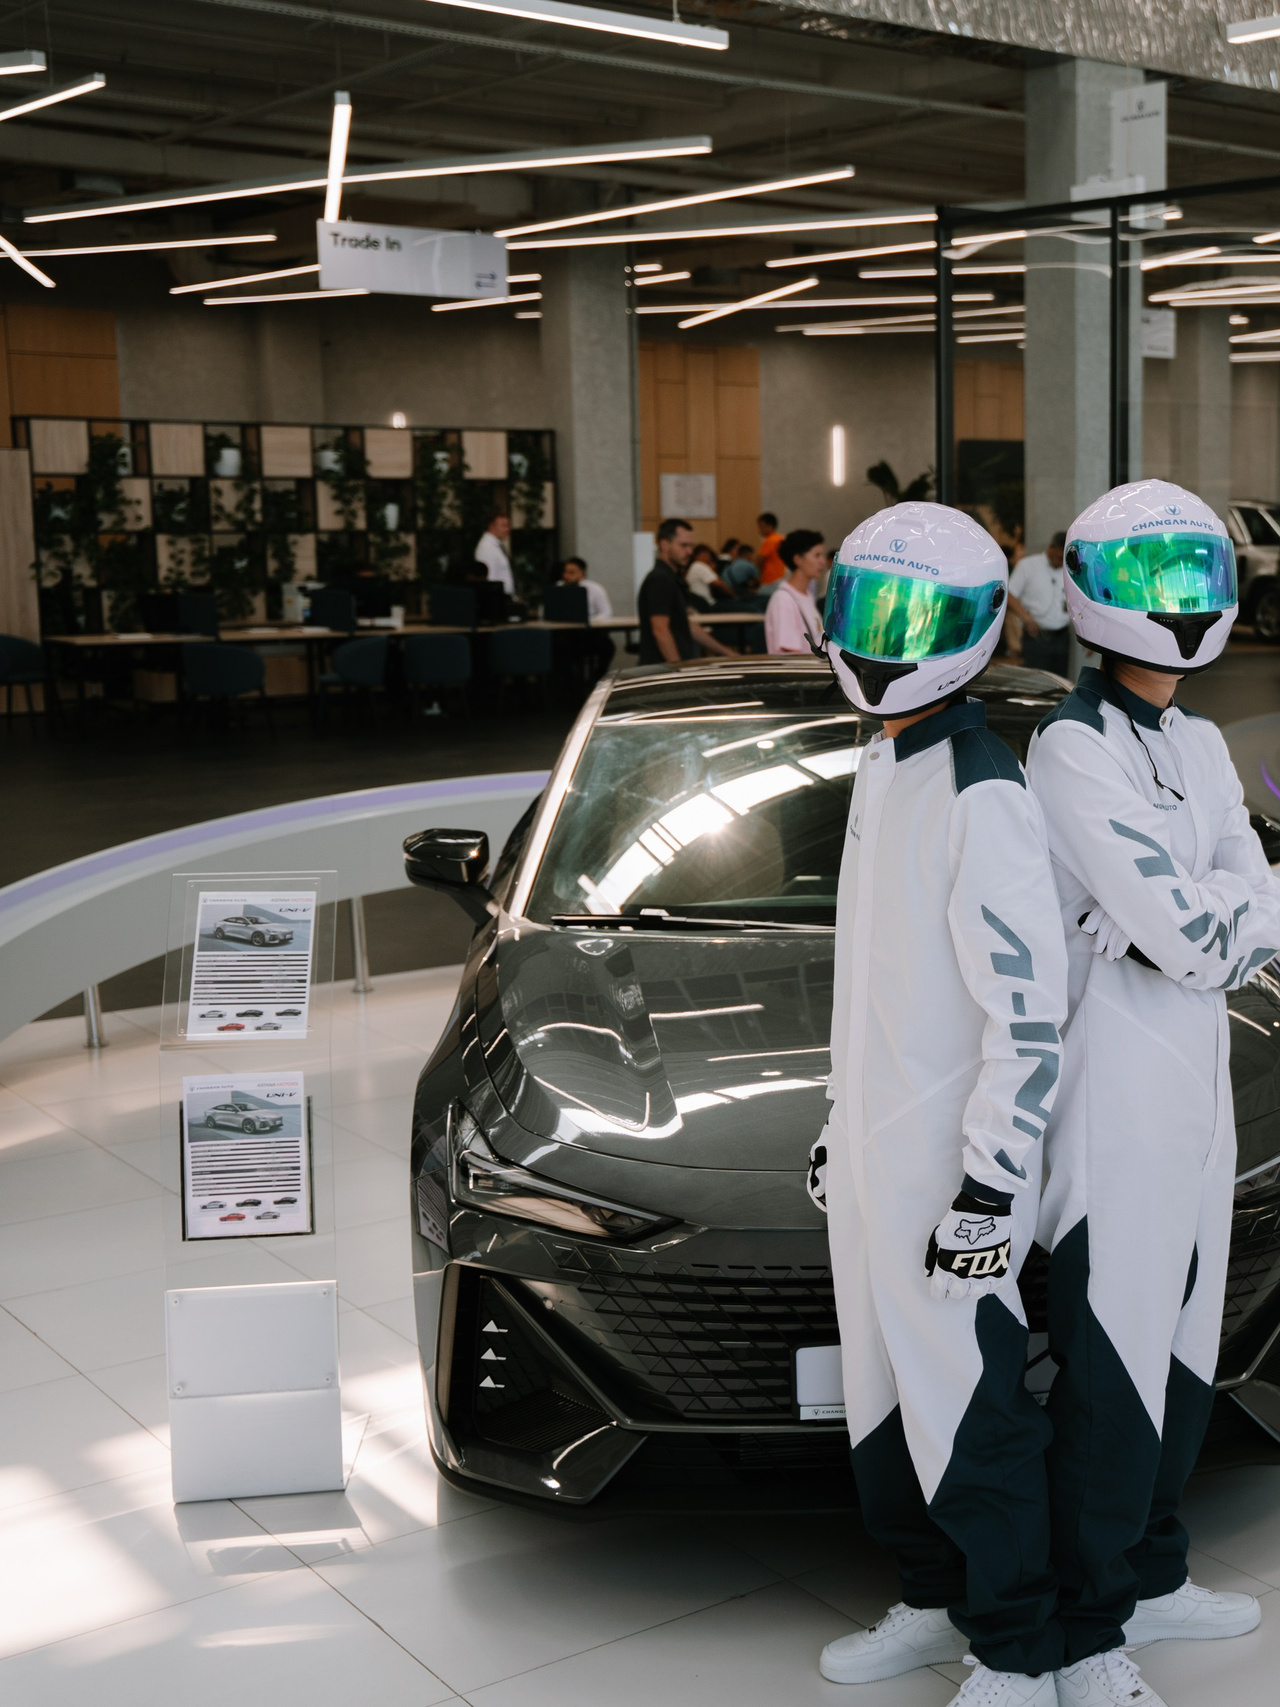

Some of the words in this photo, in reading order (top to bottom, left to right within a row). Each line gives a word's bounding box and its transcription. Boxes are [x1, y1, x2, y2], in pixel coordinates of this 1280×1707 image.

[331, 232, 380, 250] Trade
[385, 237, 402, 252] In
[1131, 519, 1188, 532] CHANGAN
[1190, 521, 1214, 531] AUTO
[854, 554, 905, 565] CHANGAN
[907, 561, 940, 576] AUTO
[951, 1241, 1011, 1277] FOX
